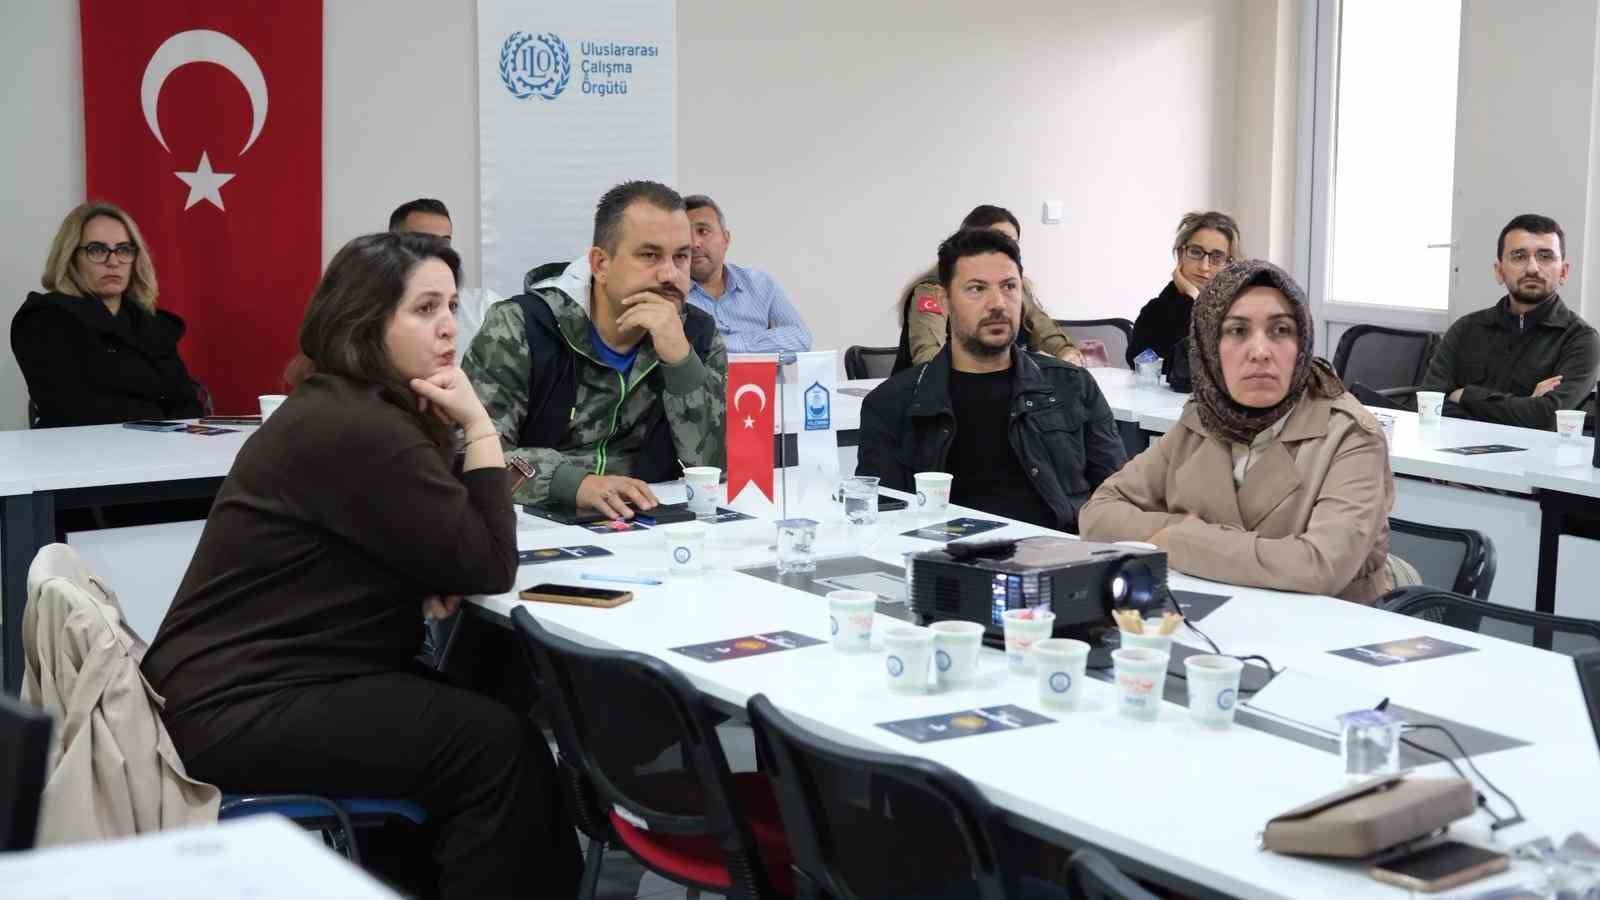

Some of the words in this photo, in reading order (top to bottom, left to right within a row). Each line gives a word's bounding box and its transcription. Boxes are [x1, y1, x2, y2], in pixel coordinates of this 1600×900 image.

[580, 42, 658, 57] Uluslararası
[520, 45, 551, 78] ILO
[580, 60, 632, 77] Çalışma
[581, 76, 628, 97] Örgütü
